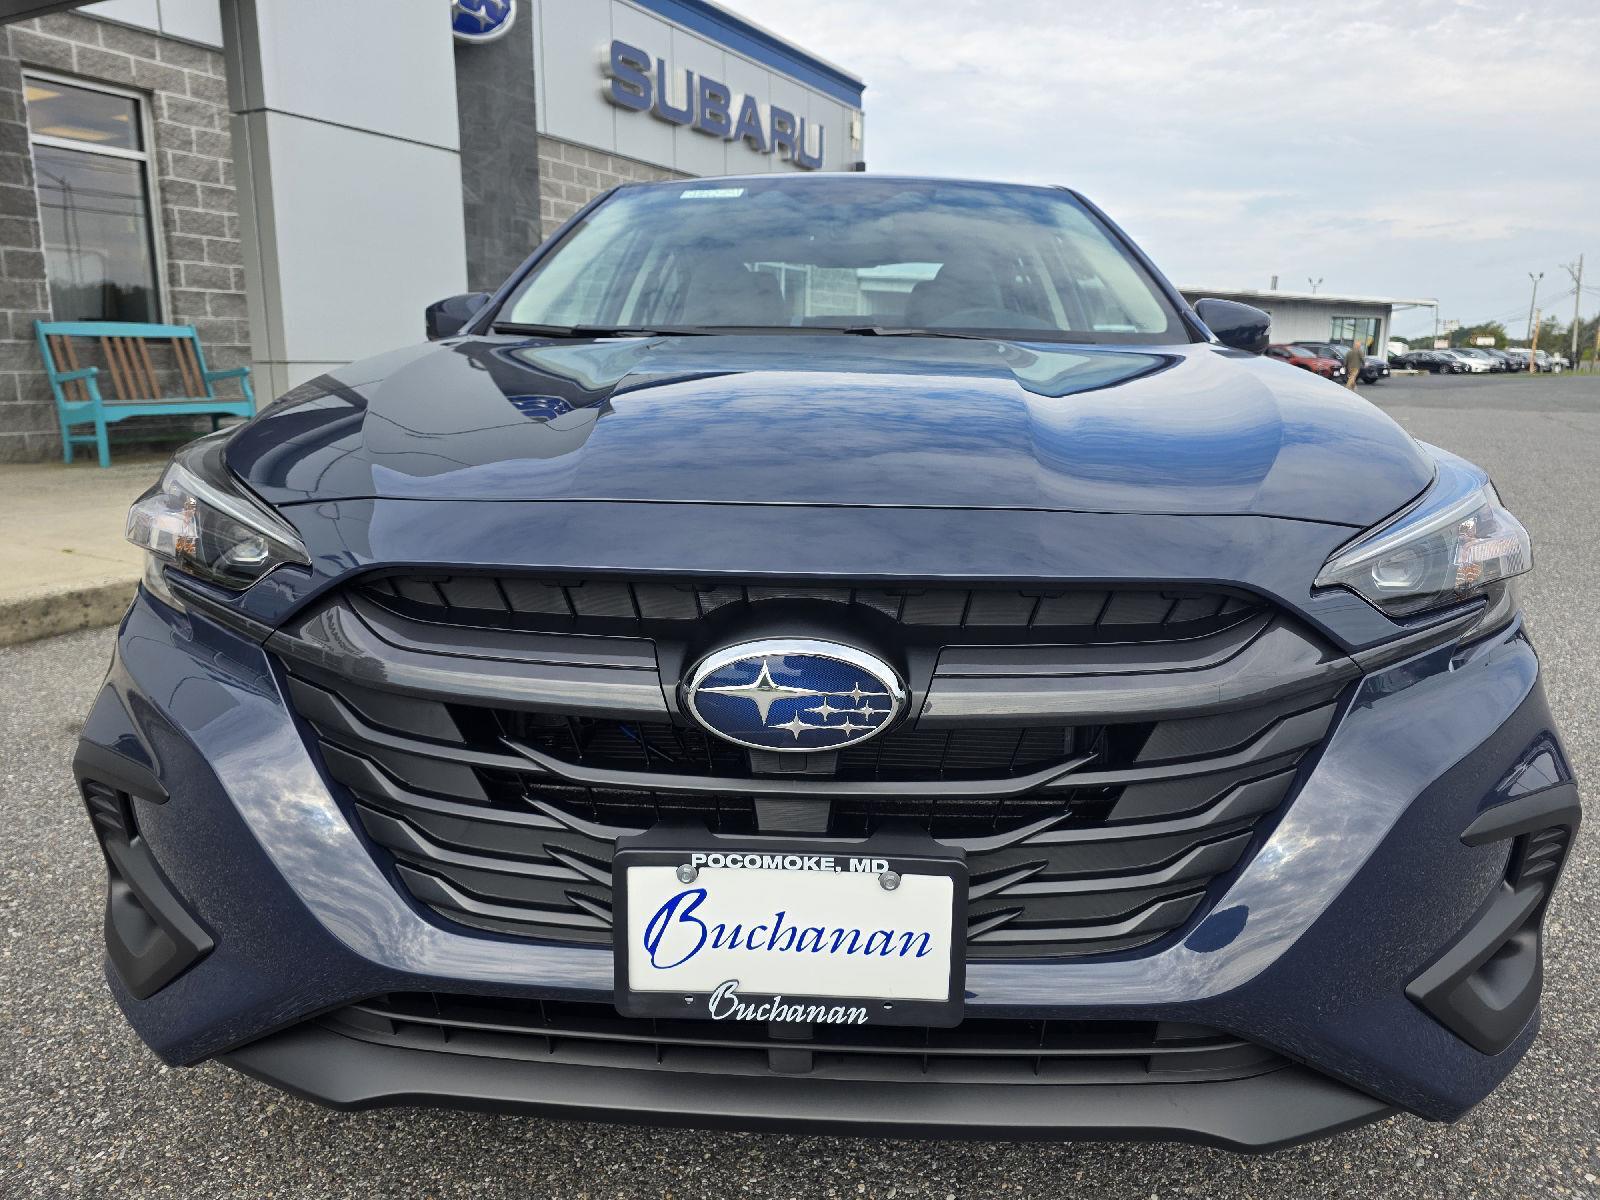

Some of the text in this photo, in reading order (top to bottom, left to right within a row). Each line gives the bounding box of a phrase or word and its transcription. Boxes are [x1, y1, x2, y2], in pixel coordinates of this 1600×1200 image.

[609, 39, 824, 169] SUBARU
[691, 853, 890, 874] POCOMOKE, MD
[643, 888, 933, 970] Buchanan
[708, 979, 869, 1025] Buchanan
